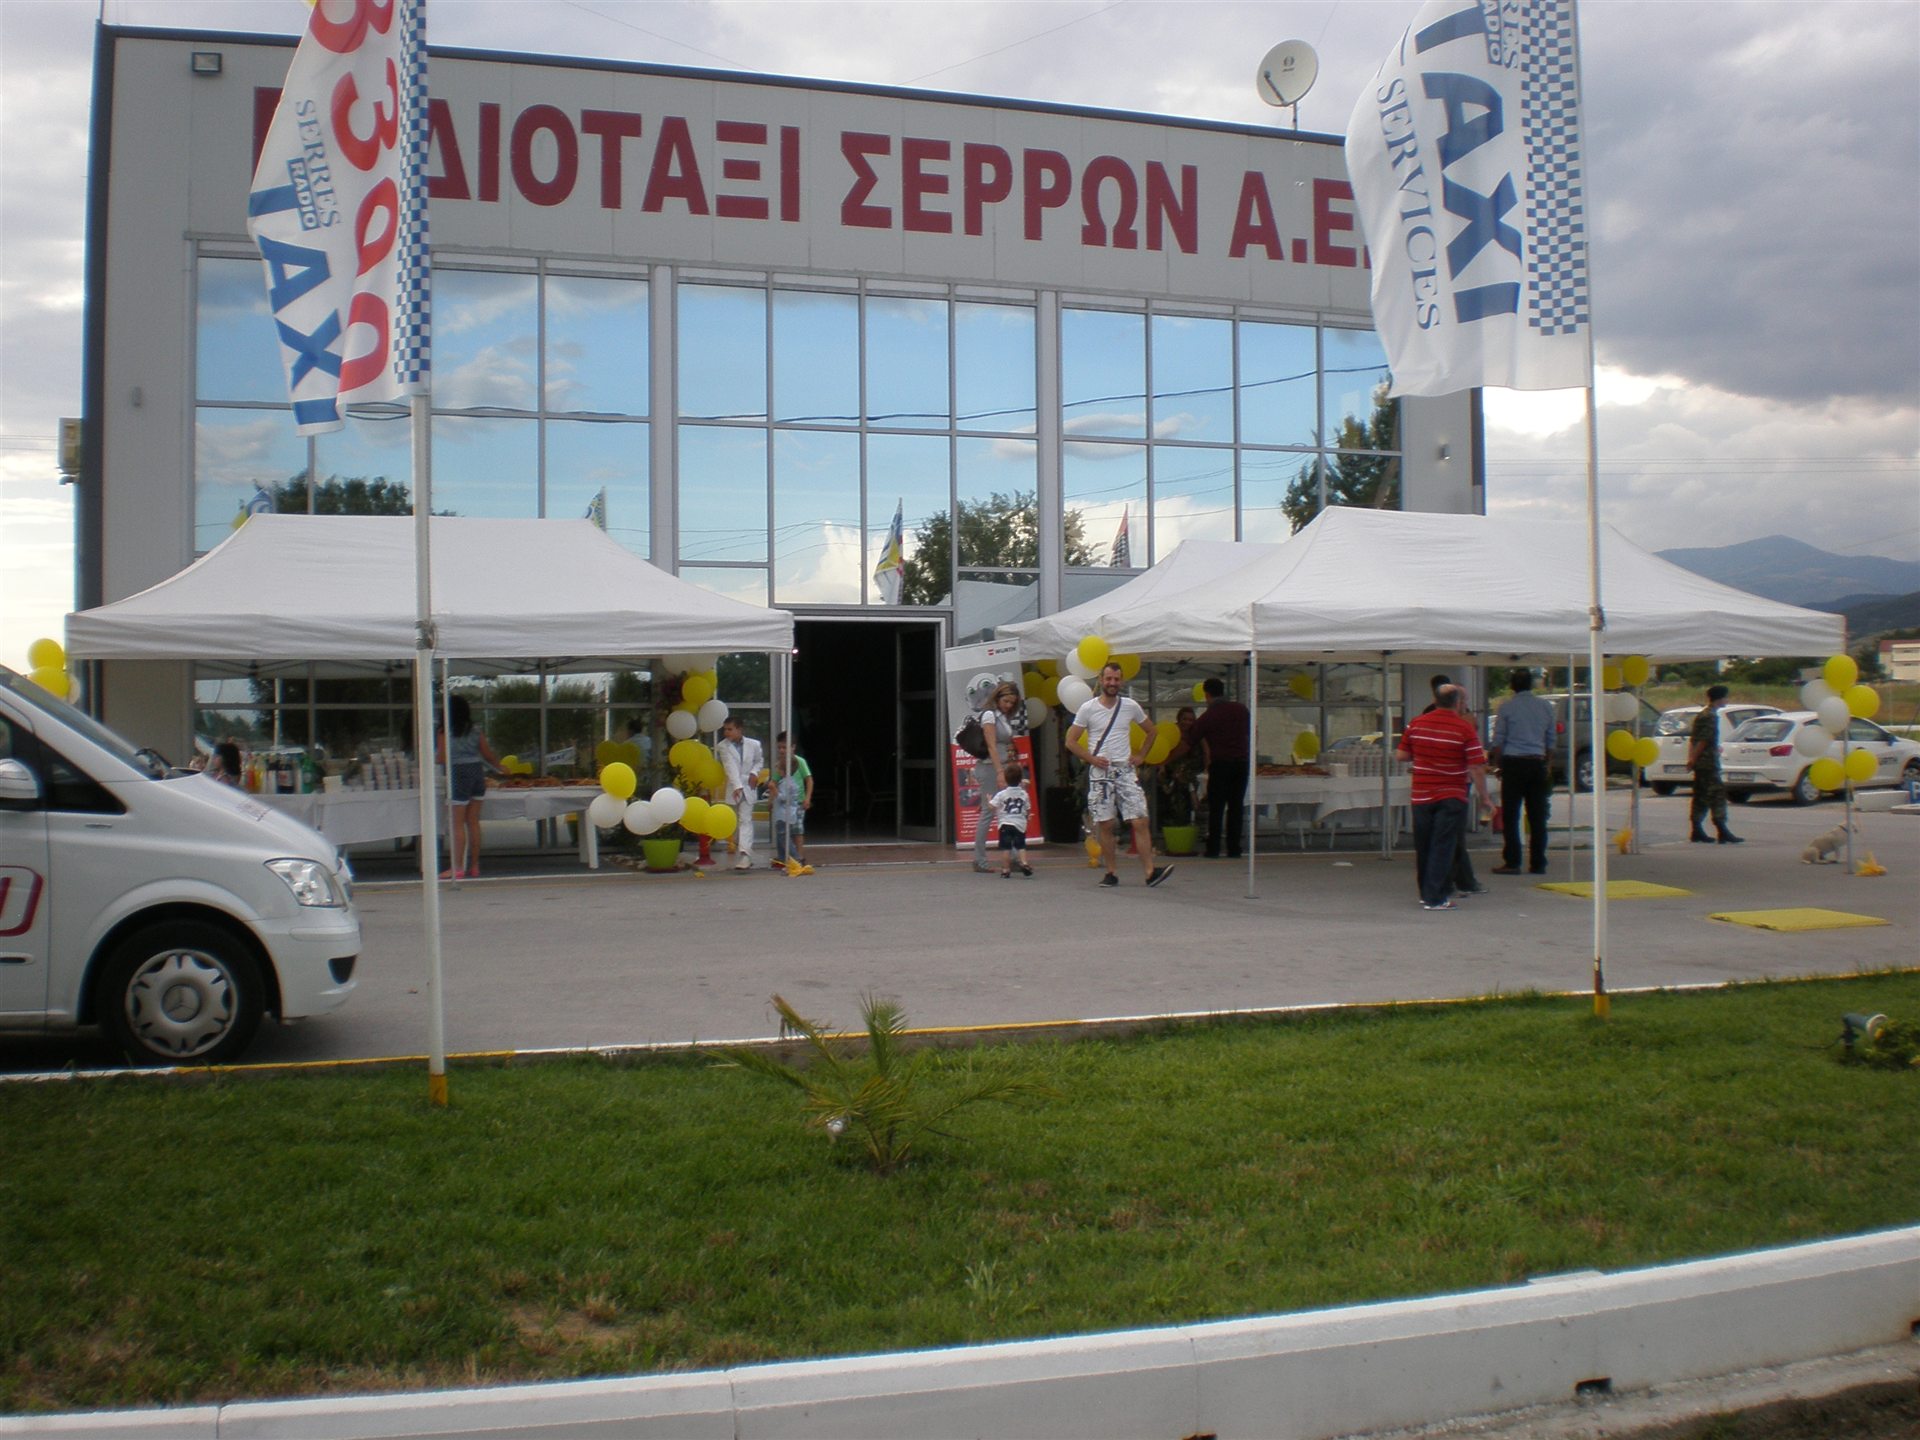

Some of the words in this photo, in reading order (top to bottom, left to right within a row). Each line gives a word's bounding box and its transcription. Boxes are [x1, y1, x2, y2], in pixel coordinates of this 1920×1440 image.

[1482, 0, 1501, 63] ADIO
[289, 160, 319, 230] RADIO
[296, 99, 343, 228] SERRES
[841, 131, 1198, 254] ΣΕΡΡΩΝ
[1376, 78, 1441, 331] SERVICES
[1415, 5, 1523, 323] TAXI
[248, 181, 343, 425] TAXI
